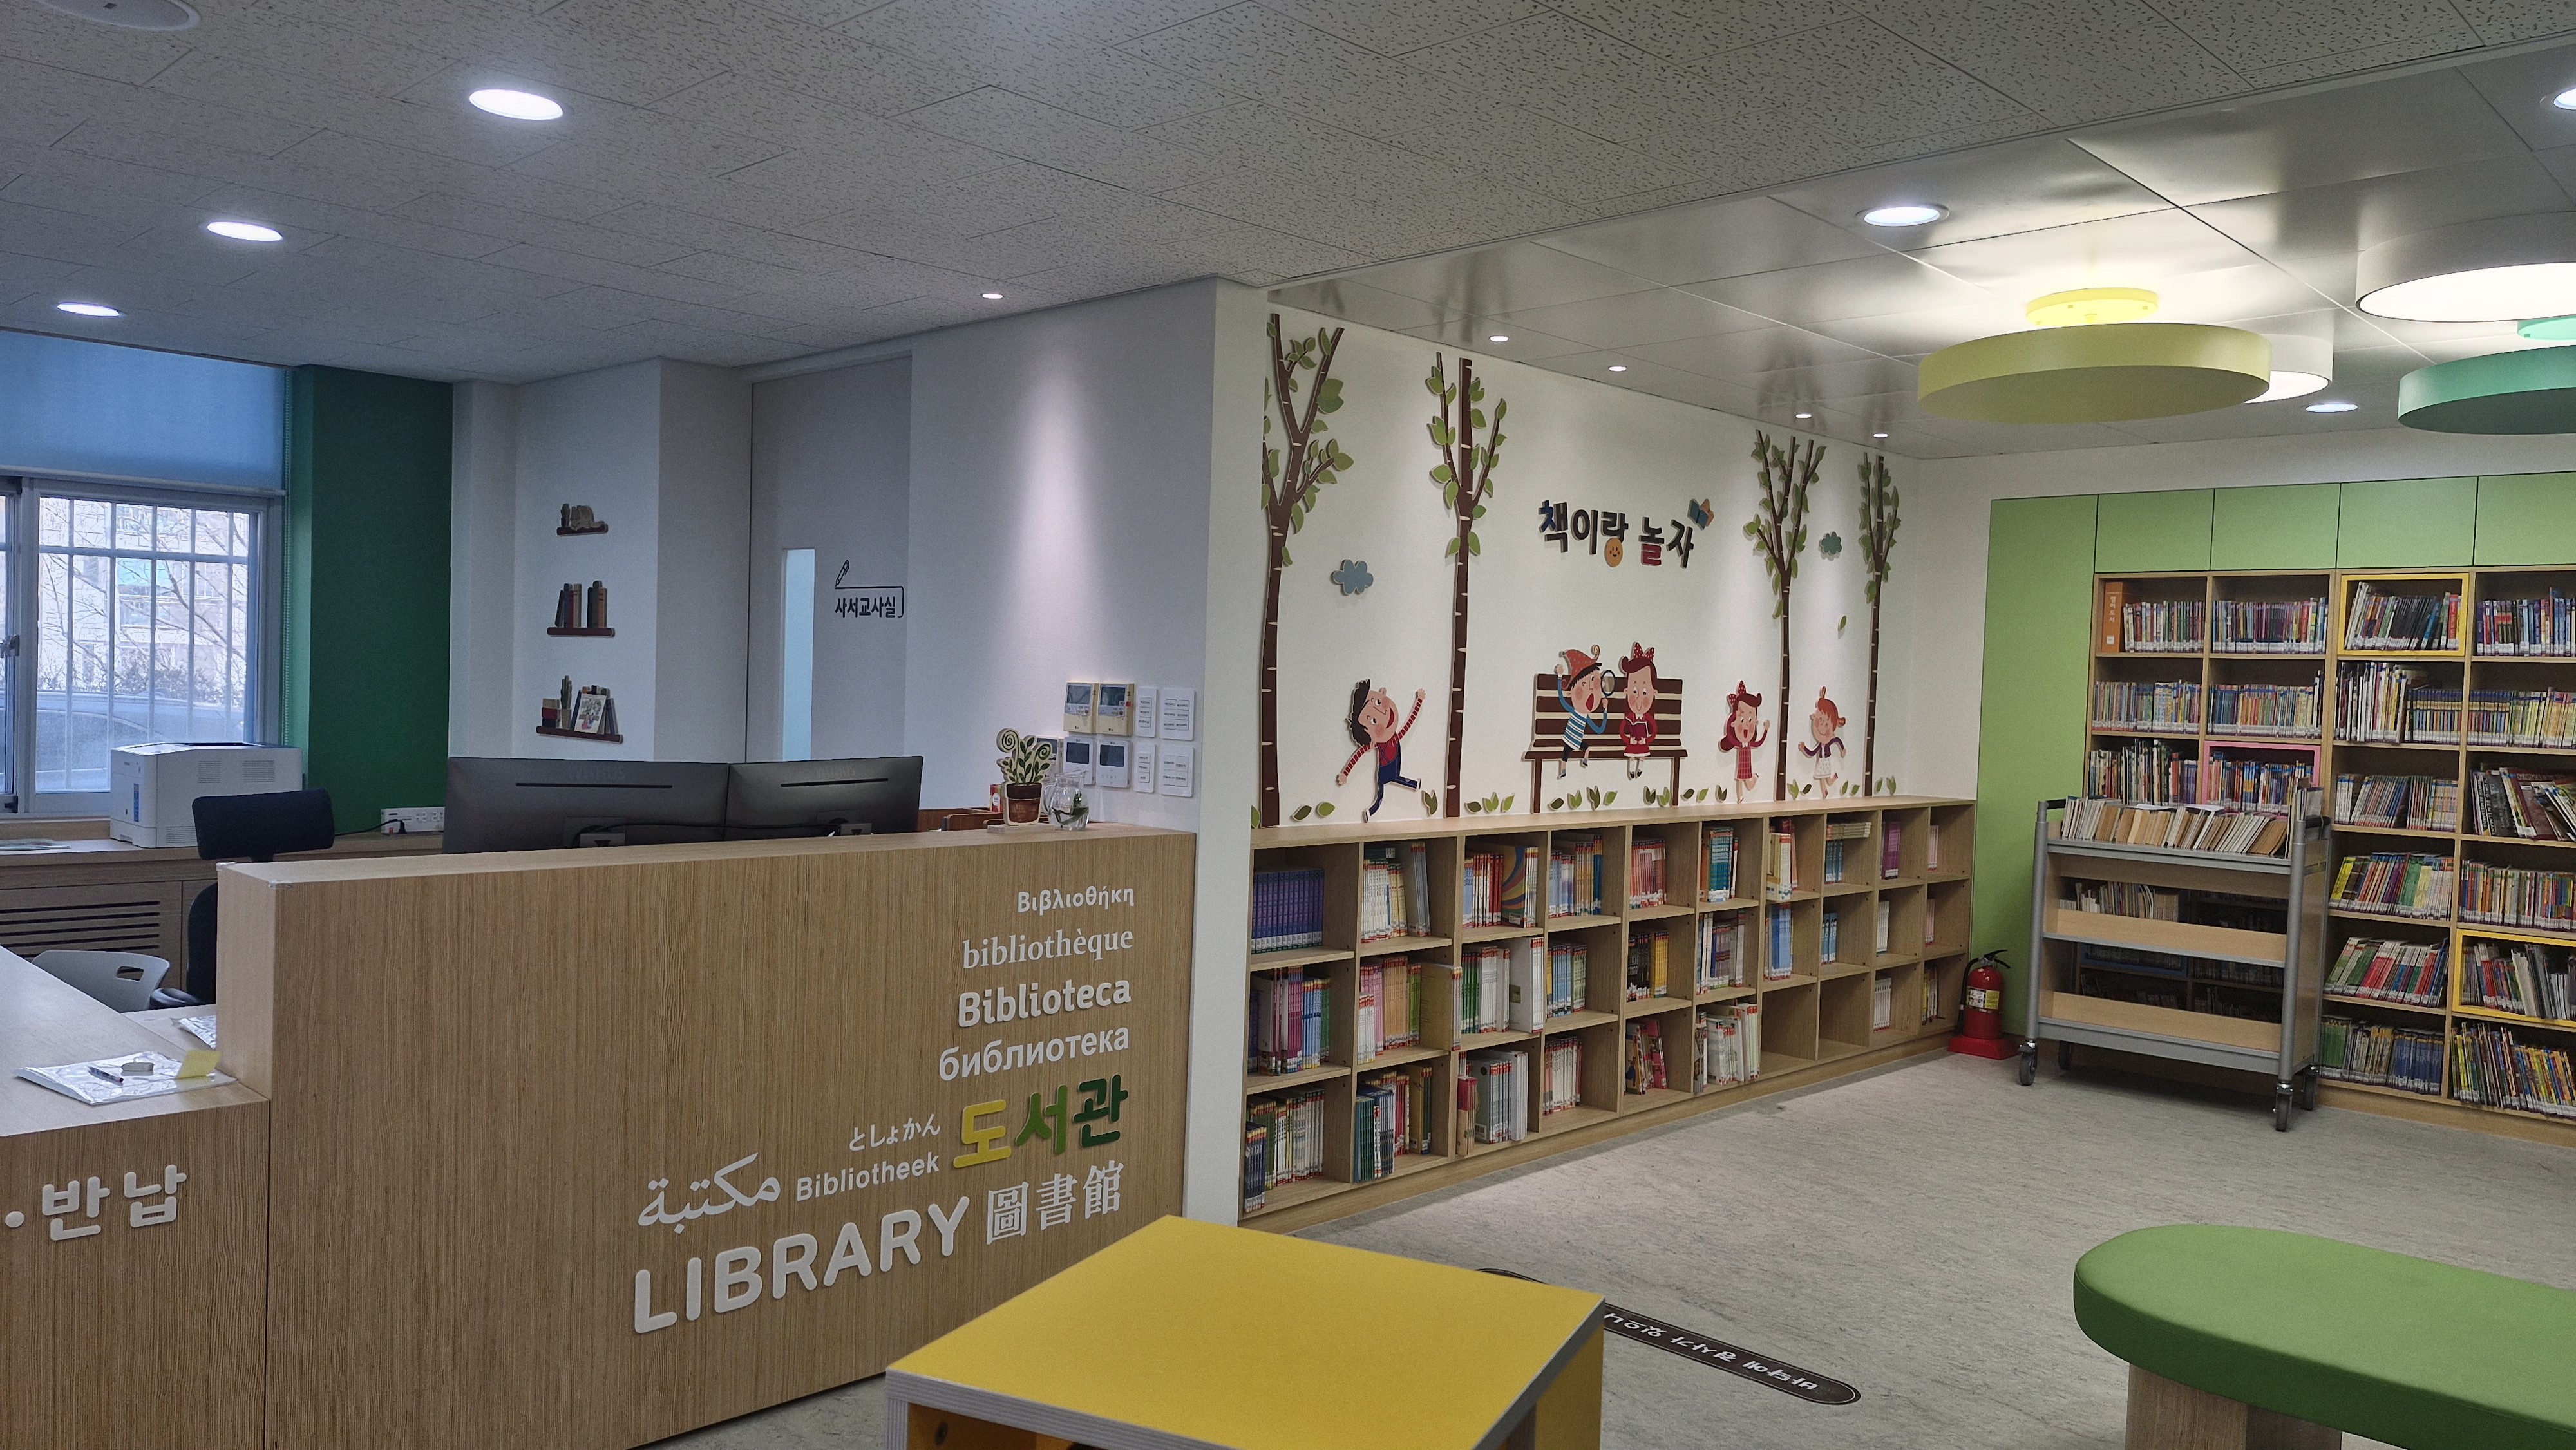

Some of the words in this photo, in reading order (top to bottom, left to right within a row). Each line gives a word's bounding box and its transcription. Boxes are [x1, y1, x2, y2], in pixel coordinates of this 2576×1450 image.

[1539, 499, 1629, 567] 책이랑
[1639, 516, 1694, 569] 놀자
[835, 596, 896, 618] 사서교사실
[2108, 595, 2117, 623] 영어도서
[1018, 885, 1135, 914] Βιβλιοθήκη
[962, 927, 1133, 970] bibliothèque
[957, 979, 1132, 1028] Biblioteca
[938, 1027, 1130, 1082] библиотека
[849, 1113, 941, 1151] としょかん
[953, 1075, 1128, 1169] 도서관
[637, 1153, 781, 1234] مكتبة
[796, 1151, 940, 1201] Bibliotheek
[986, 1160, 1124, 1245] 圖書館
[634, 1196, 971, 1334] LIBRARY
[1670, 1336, 1737, 1362] 경사가
[1742, 1360, 1819, 1391] 바닥에
